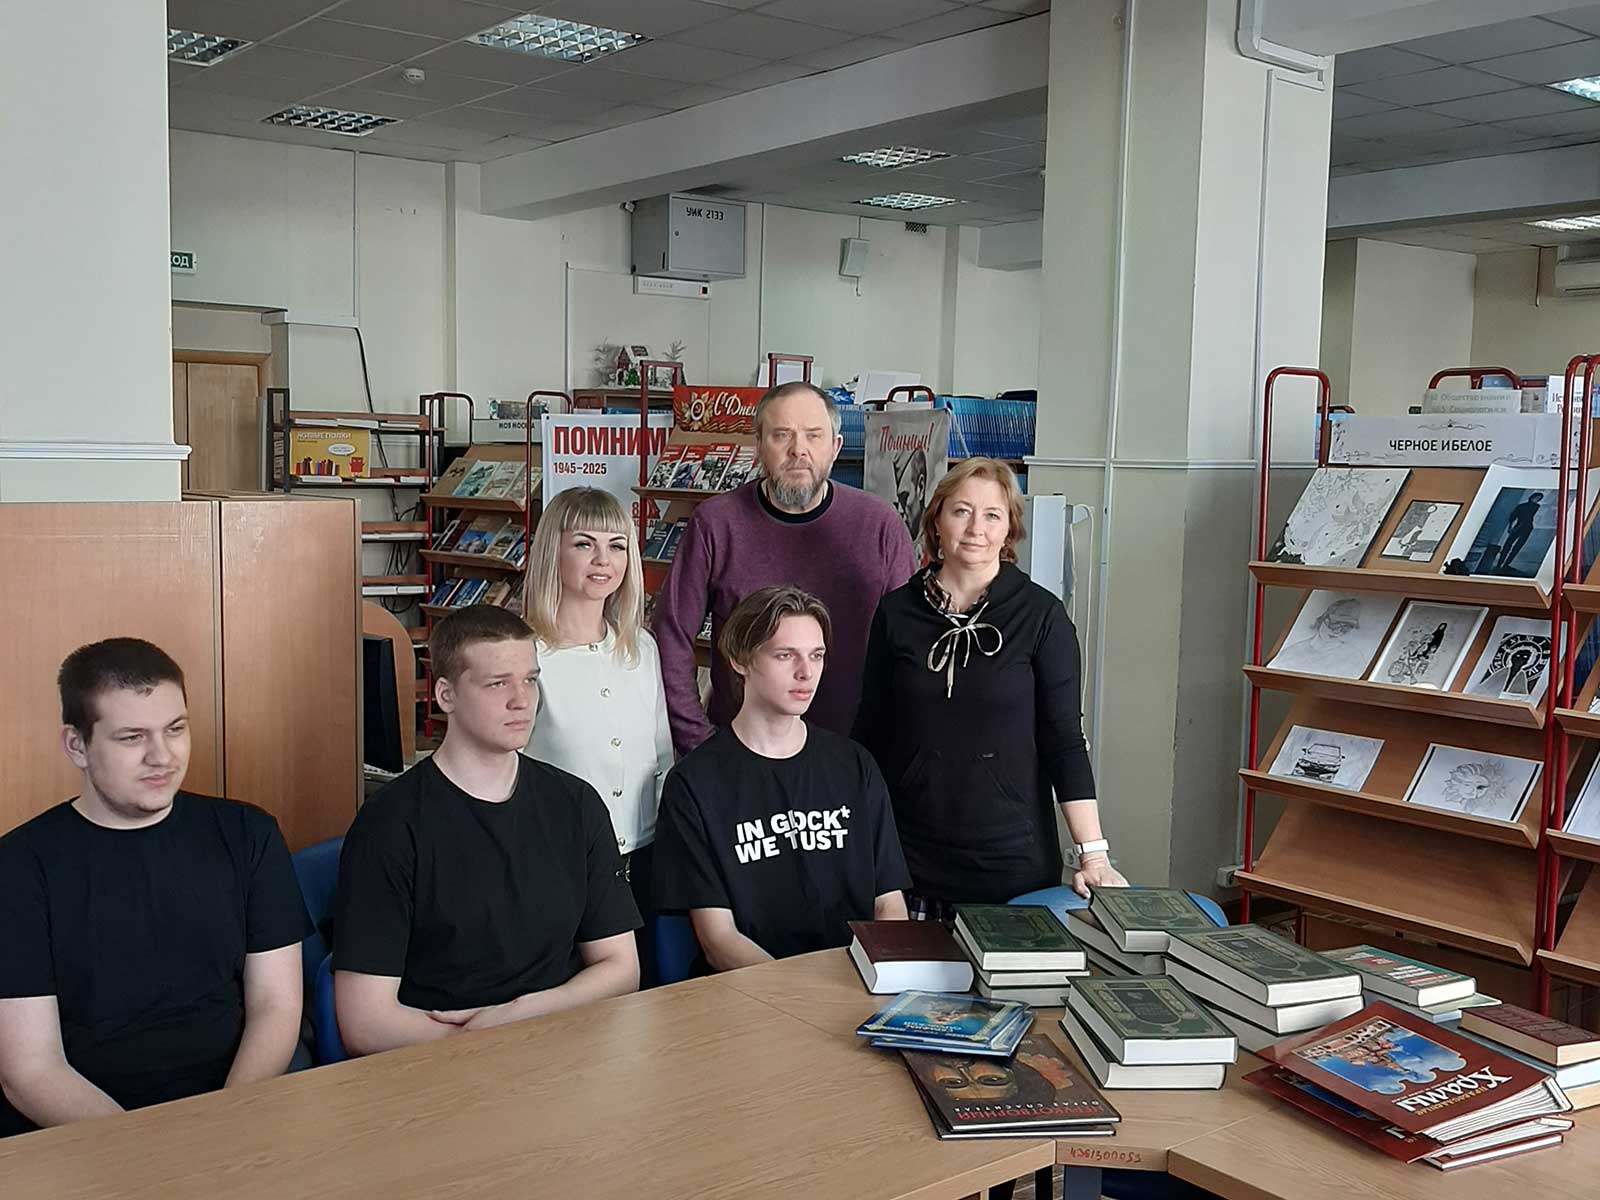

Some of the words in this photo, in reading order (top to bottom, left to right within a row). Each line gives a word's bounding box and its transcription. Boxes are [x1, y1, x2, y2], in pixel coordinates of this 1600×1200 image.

[706, 209, 724, 221] 2133
[879, 421, 934, 452] Помним!
[1389, 439, 1438, 452] ЧЕРНОЕ
[553, 462, 607, 475] 1945–2025
[736, 818, 765, 844] IN
[734, 835, 780, 864] WE
[1395, 1066, 1513, 1112] Храмы
